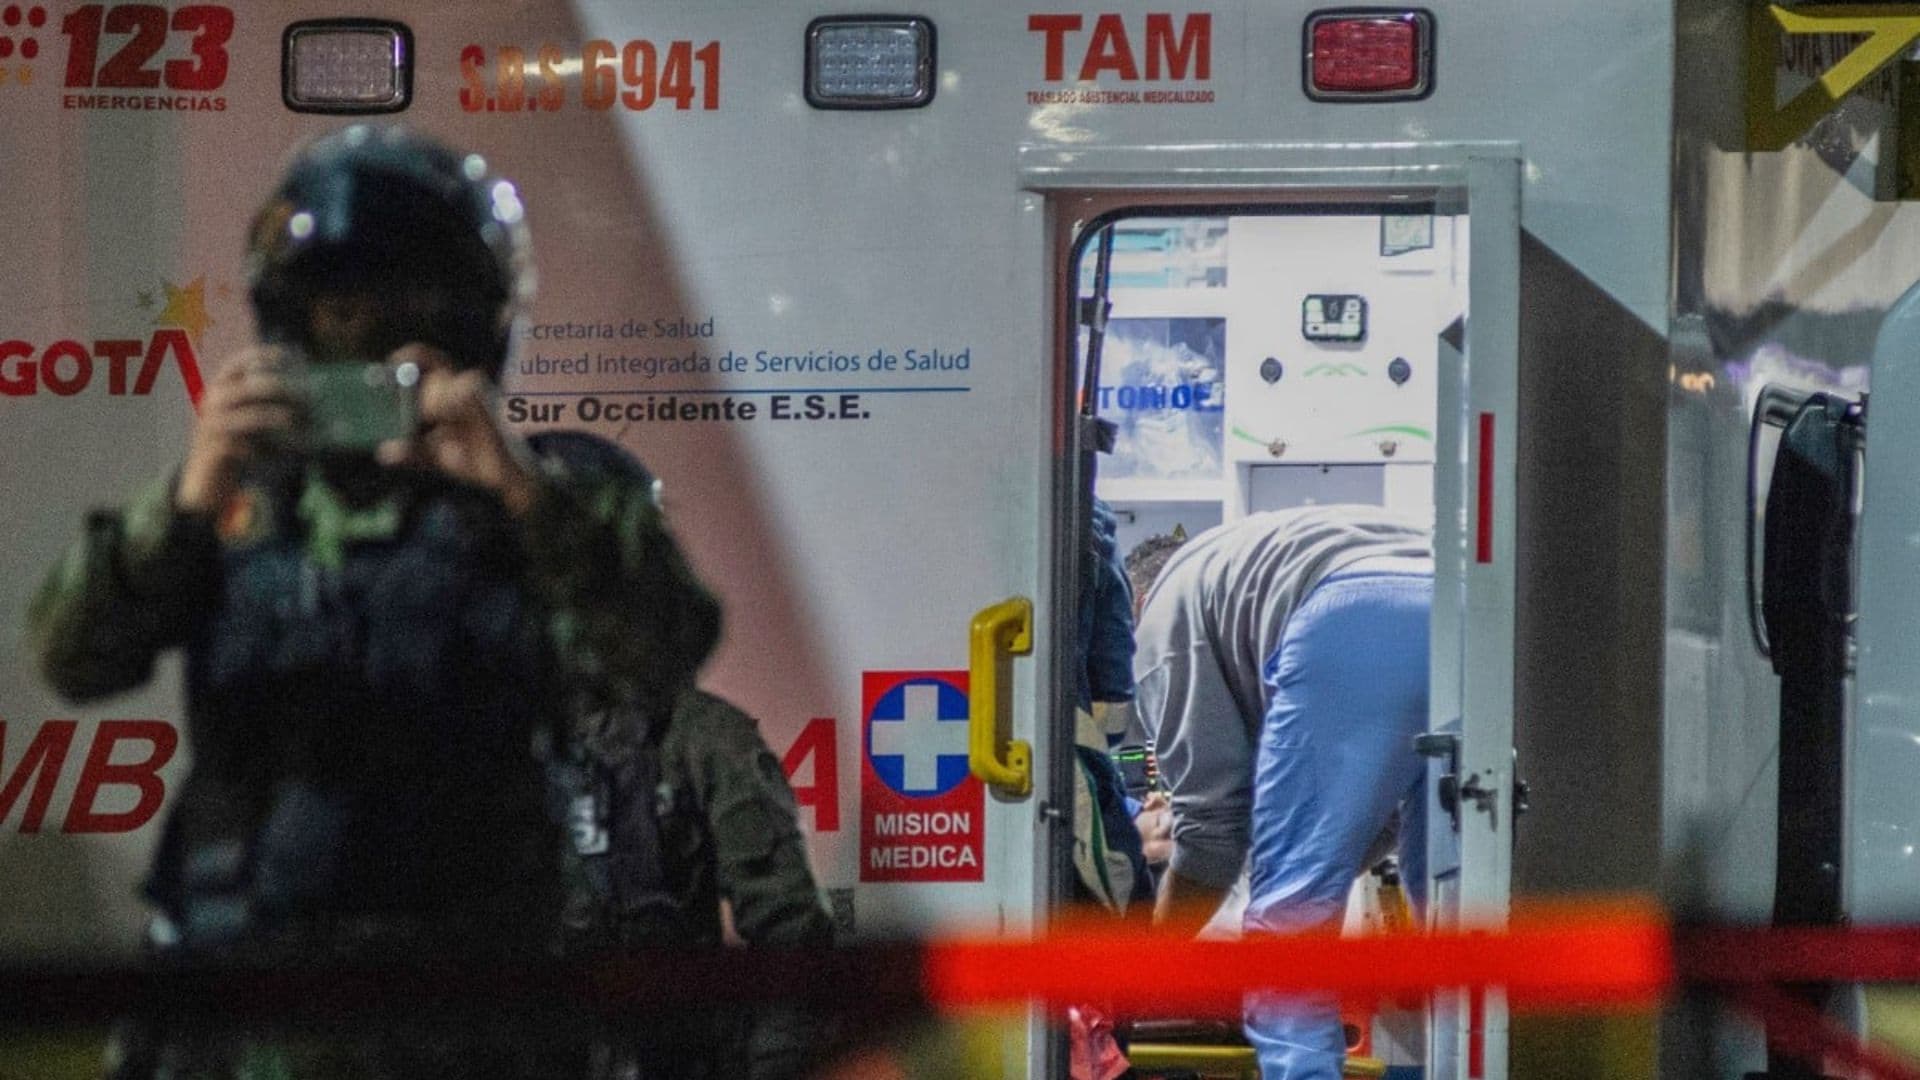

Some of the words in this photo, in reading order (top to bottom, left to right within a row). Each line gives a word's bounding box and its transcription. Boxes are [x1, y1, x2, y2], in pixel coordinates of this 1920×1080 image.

[62, 4, 235, 91] 123
[1028, 13, 1212, 81] TAM
[581, 39, 721, 112] 6941
[63, 95, 227, 111] EMERGENCIAS
[620, 318, 648, 338] de
[654, 317, 714, 338] Salud
[521, 353, 589, 375] ubred
[598, 351, 712, 379] Integrada
[719, 351, 749, 373] de
[755, 351, 861, 373] Servicios
[868, 349, 897, 371] de
[904, 347, 970, 371] Salud
[508, 398, 566, 423] Sur
[577, 397, 757, 422] Occidente
[771, 394, 871, 420] E.S.E.
[875, 812, 971, 836] MISION
[871, 845, 977, 868] MEDICA
